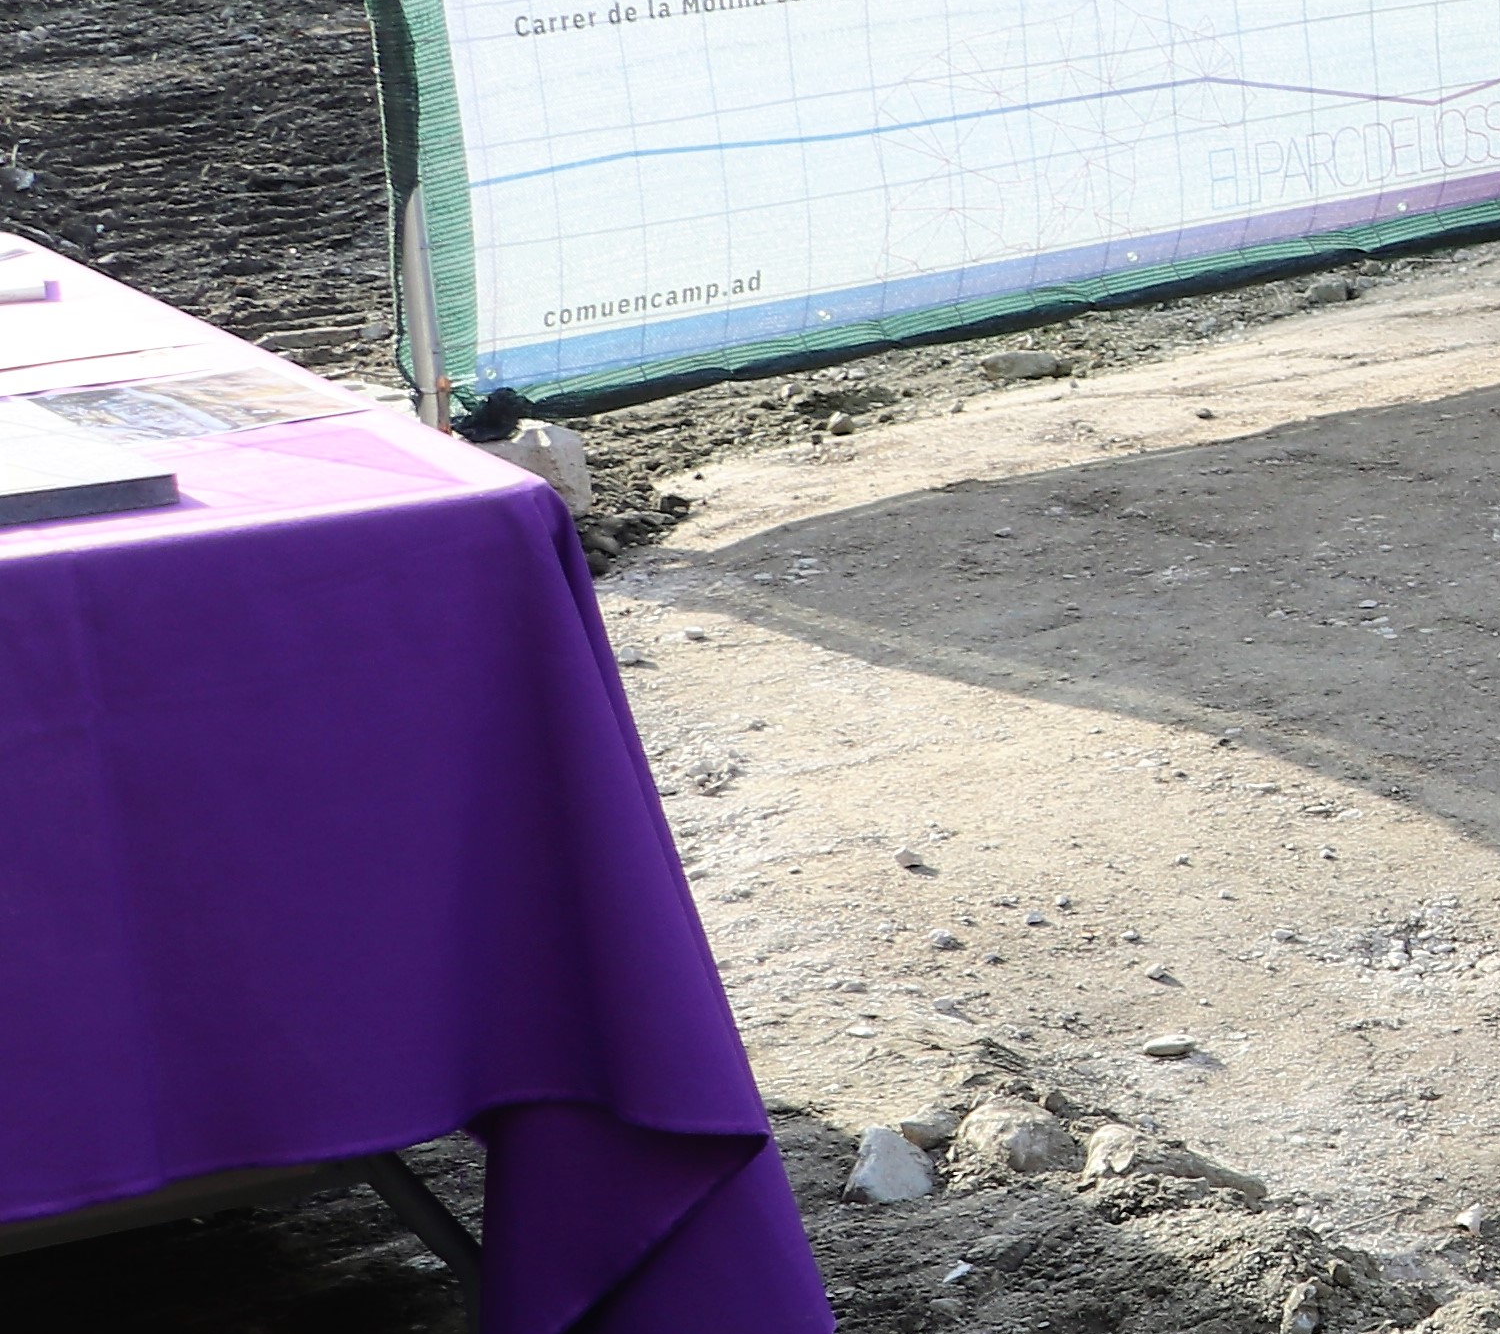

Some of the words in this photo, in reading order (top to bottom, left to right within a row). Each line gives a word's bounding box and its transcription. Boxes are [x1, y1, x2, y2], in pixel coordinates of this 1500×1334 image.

[514, 7, 597, 38] Carrer
[607, 2, 638, 26] de
[542, 269, 763, 328] comuencamp.ad
